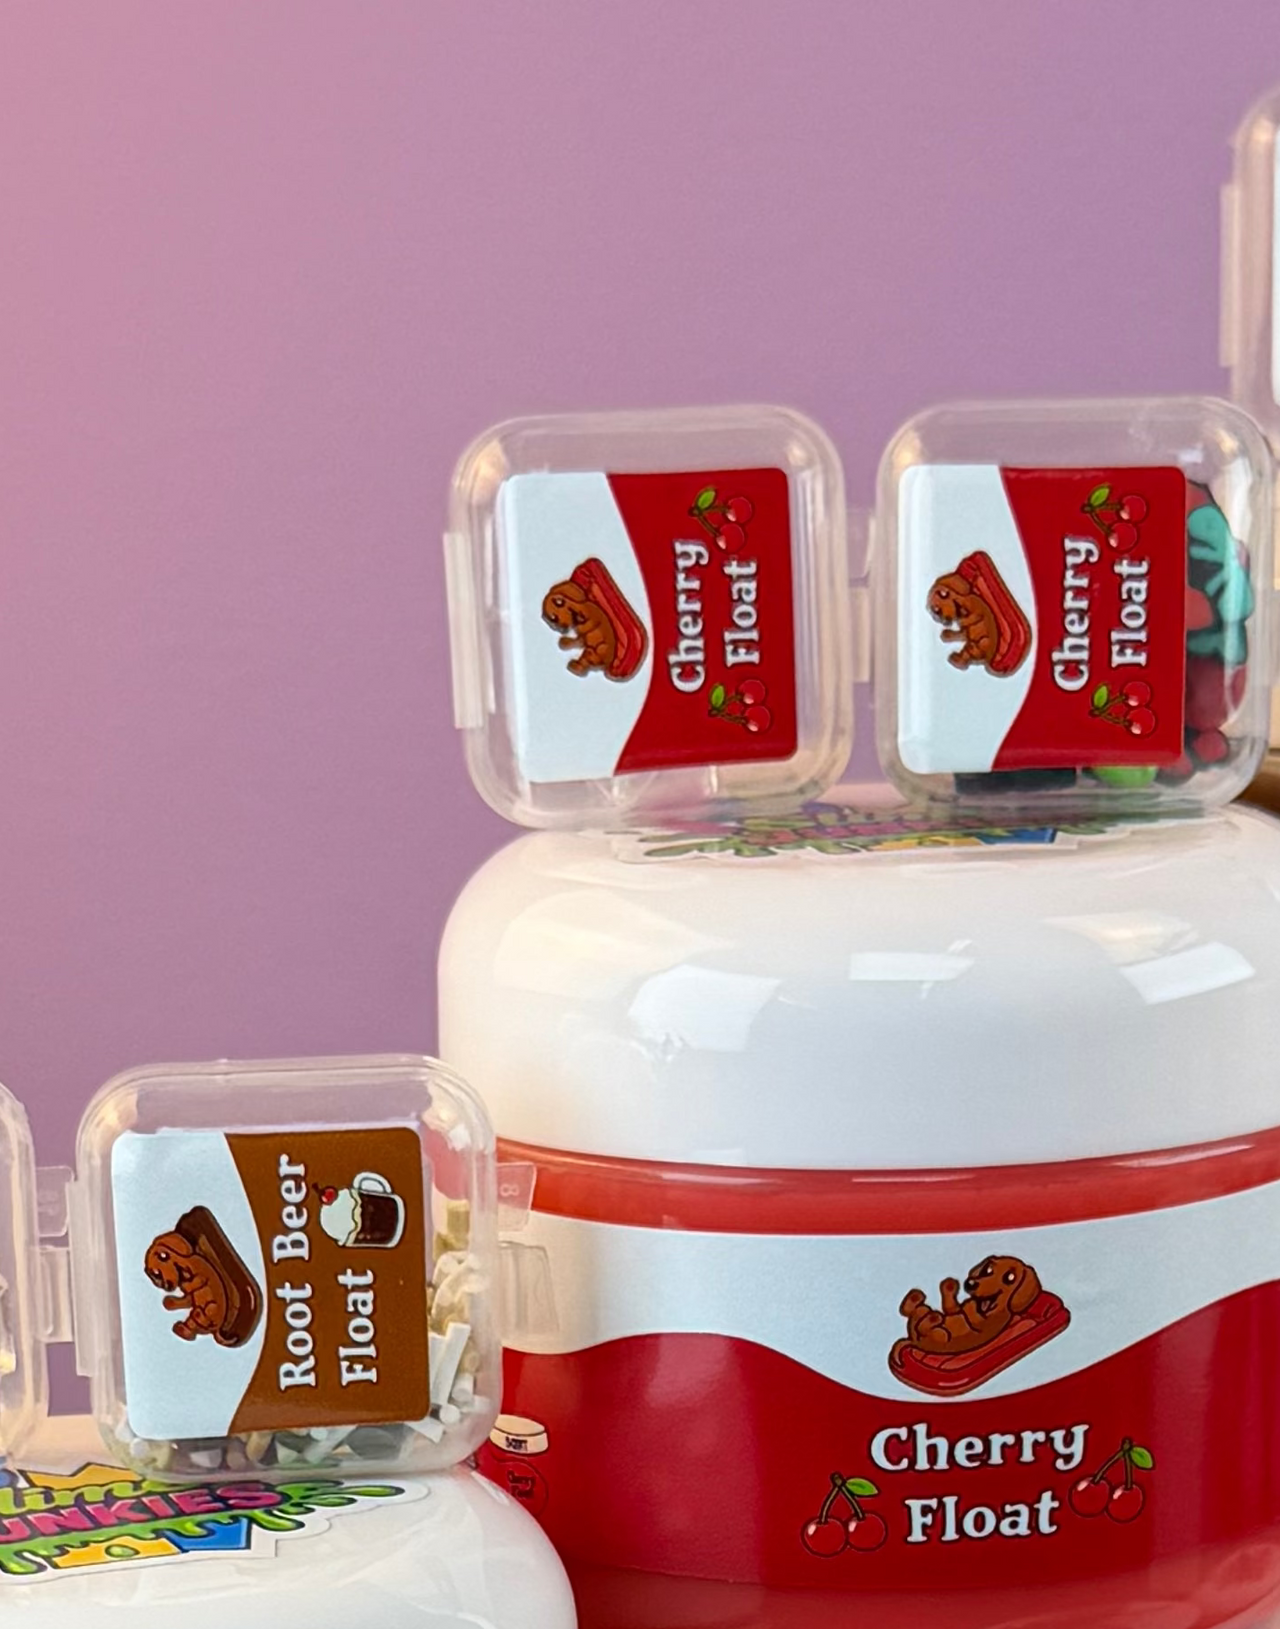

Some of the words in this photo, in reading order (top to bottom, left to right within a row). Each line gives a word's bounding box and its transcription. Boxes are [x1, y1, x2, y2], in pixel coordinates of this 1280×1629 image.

[667, 537, 710, 694] Cherry
[724, 555, 760, 668] Float
[1051, 535, 1101, 693] Cherry
[1110, 555, 1151, 668] Float
[272, 1153, 311, 1264] Beer
[275, 1280, 318, 1393] Root
[339, 1266, 378, 1386] Float
[870, 1423, 1089, 1470] Cherry
[905, 1490, 1060, 1543] Float
